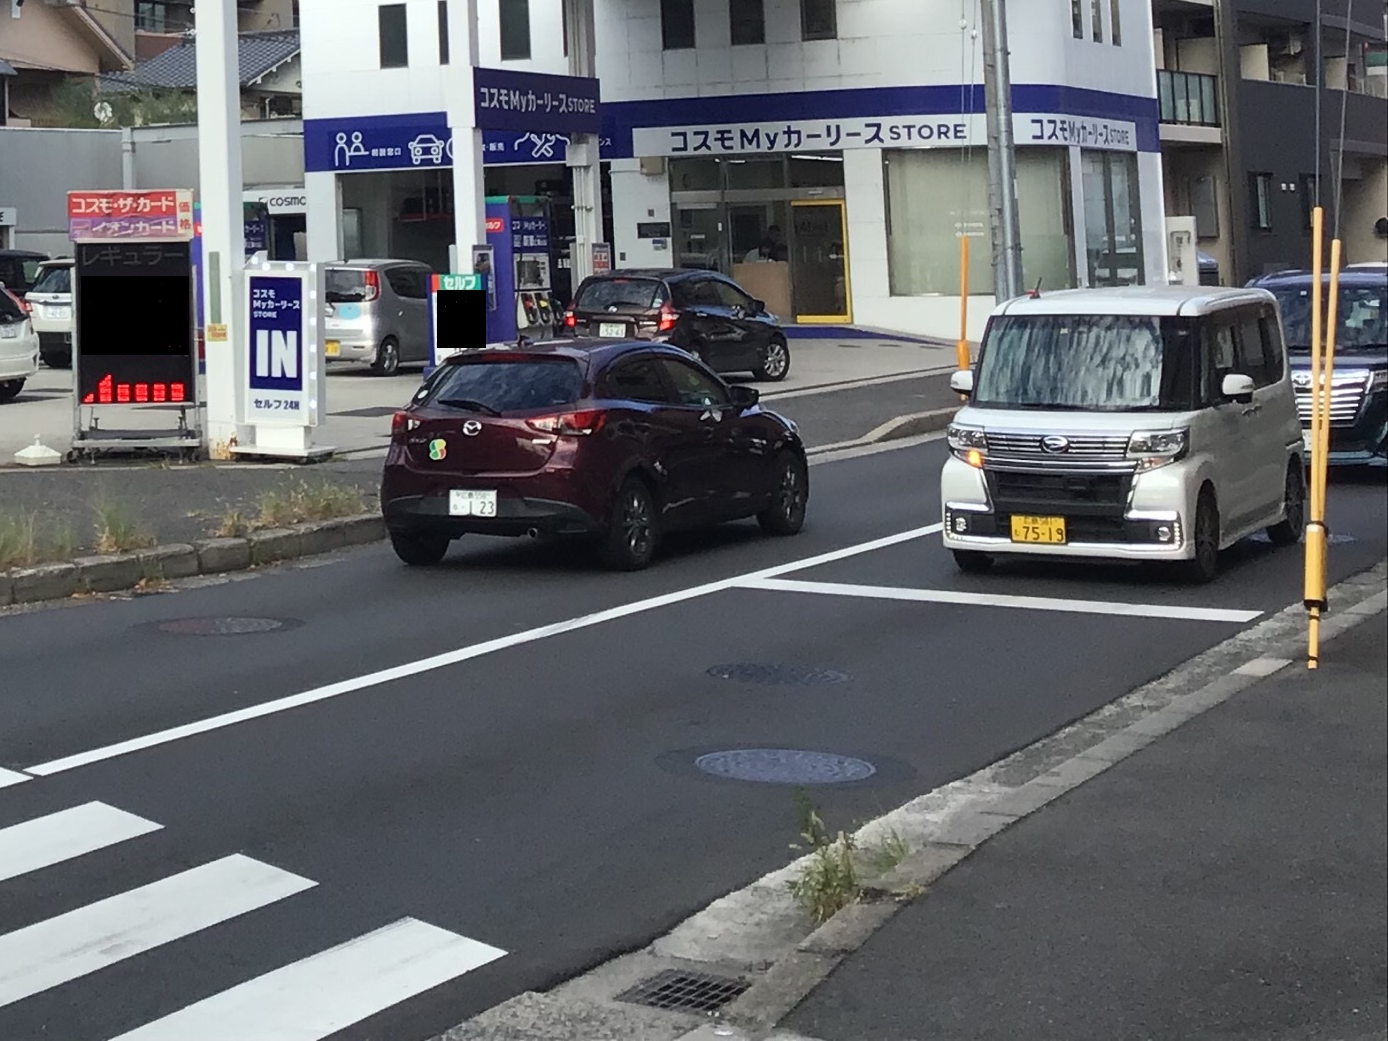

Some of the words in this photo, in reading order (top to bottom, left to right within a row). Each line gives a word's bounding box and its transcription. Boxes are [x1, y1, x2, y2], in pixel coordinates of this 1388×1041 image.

[82, 245, 184, 266] レギュラー
[443, 276, 476, 290] セルフ
[253, 289, 276, 299] コスモ
[253, 311, 277, 319] STORE
[255, 329, 298, 379] IN
[254, 398, 282, 409] セルフ
[283, 400, 300, 410] 24H
